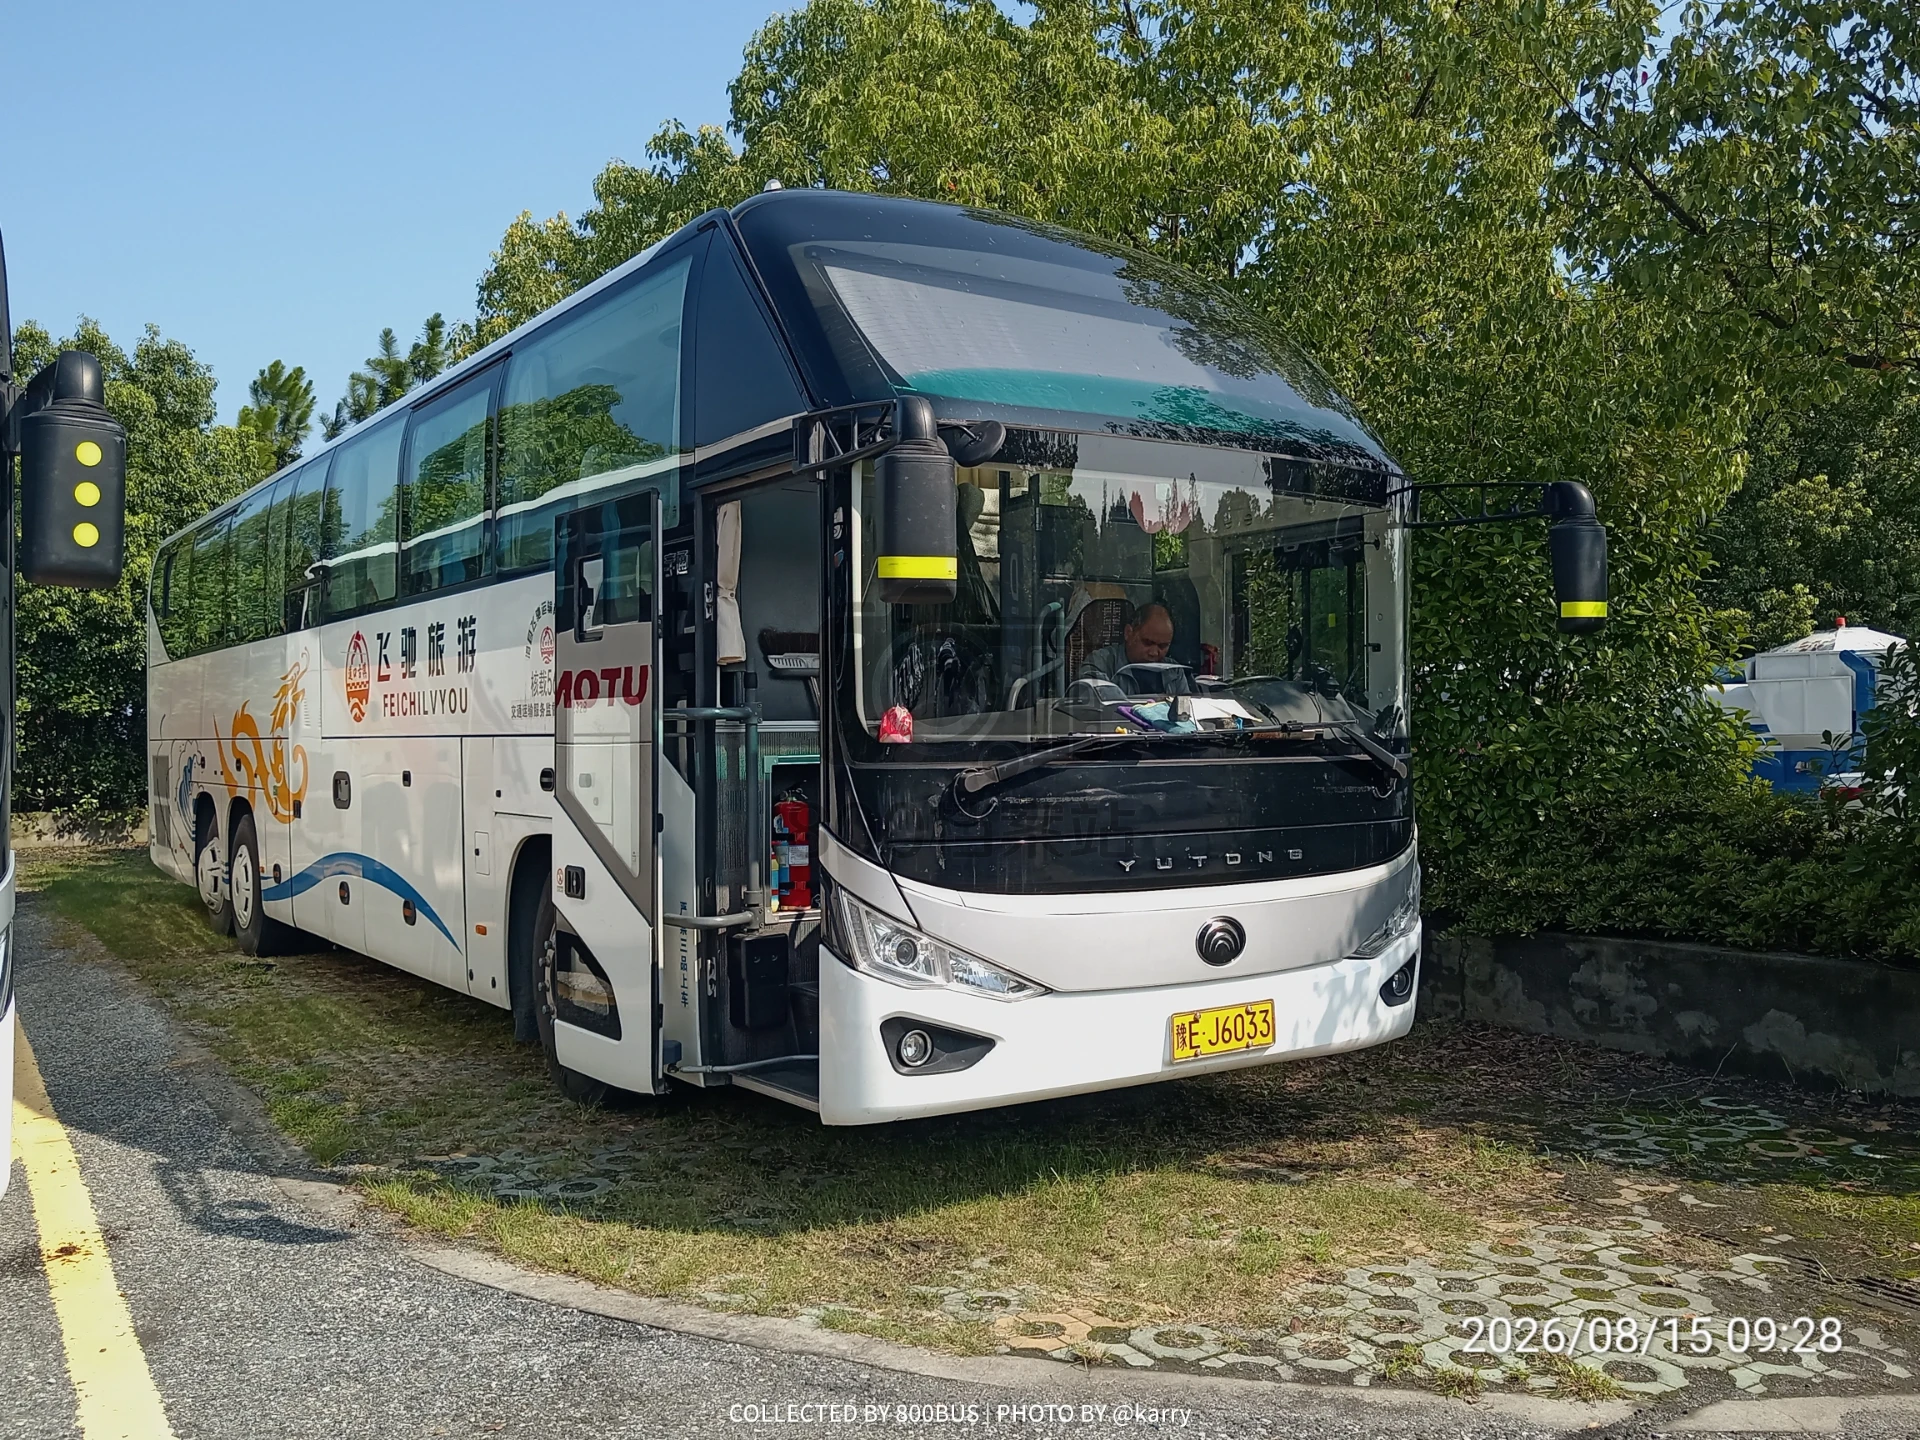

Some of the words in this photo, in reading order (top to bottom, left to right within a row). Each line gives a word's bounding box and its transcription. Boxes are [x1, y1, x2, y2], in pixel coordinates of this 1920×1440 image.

[376, 615, 477, 683] 飞驰旅游
[383, 687, 468, 717] FEICHILVYOU
[1119, 848, 1303, 873] YUTONG
